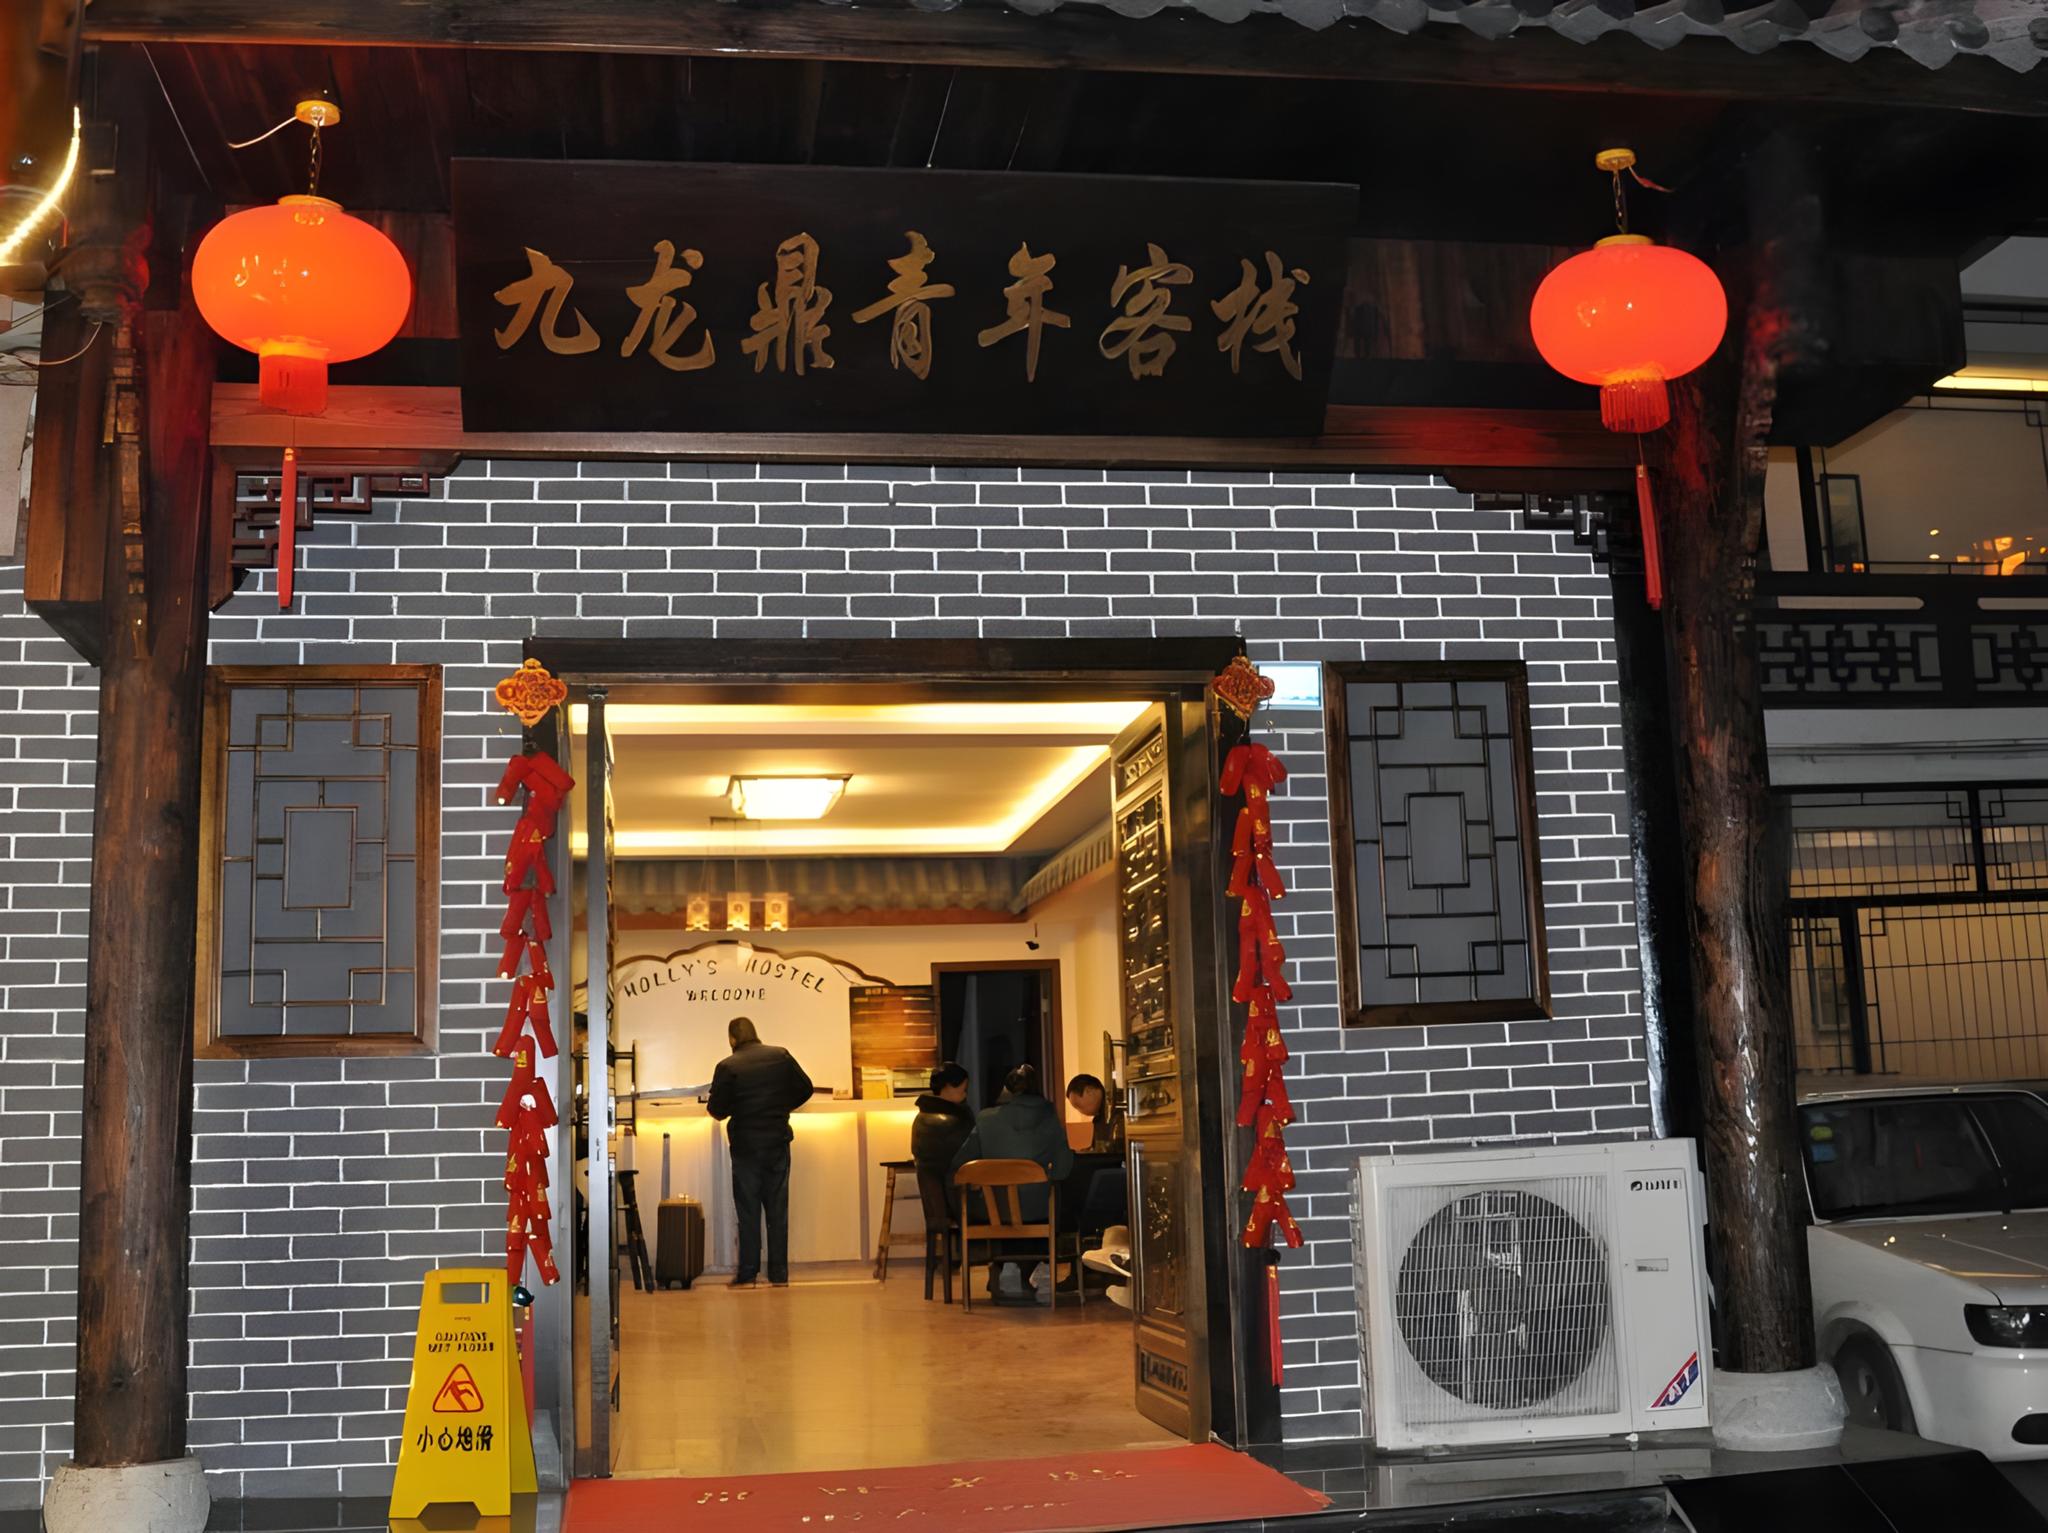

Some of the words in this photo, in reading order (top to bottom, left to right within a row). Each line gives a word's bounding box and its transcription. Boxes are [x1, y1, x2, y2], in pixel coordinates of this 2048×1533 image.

[494, 231, 1310, 383] 九龙鼎青年客栈
[624, 960, 718, 998] HOLLY'S
[745, 959, 825, 993] HOSTEL
